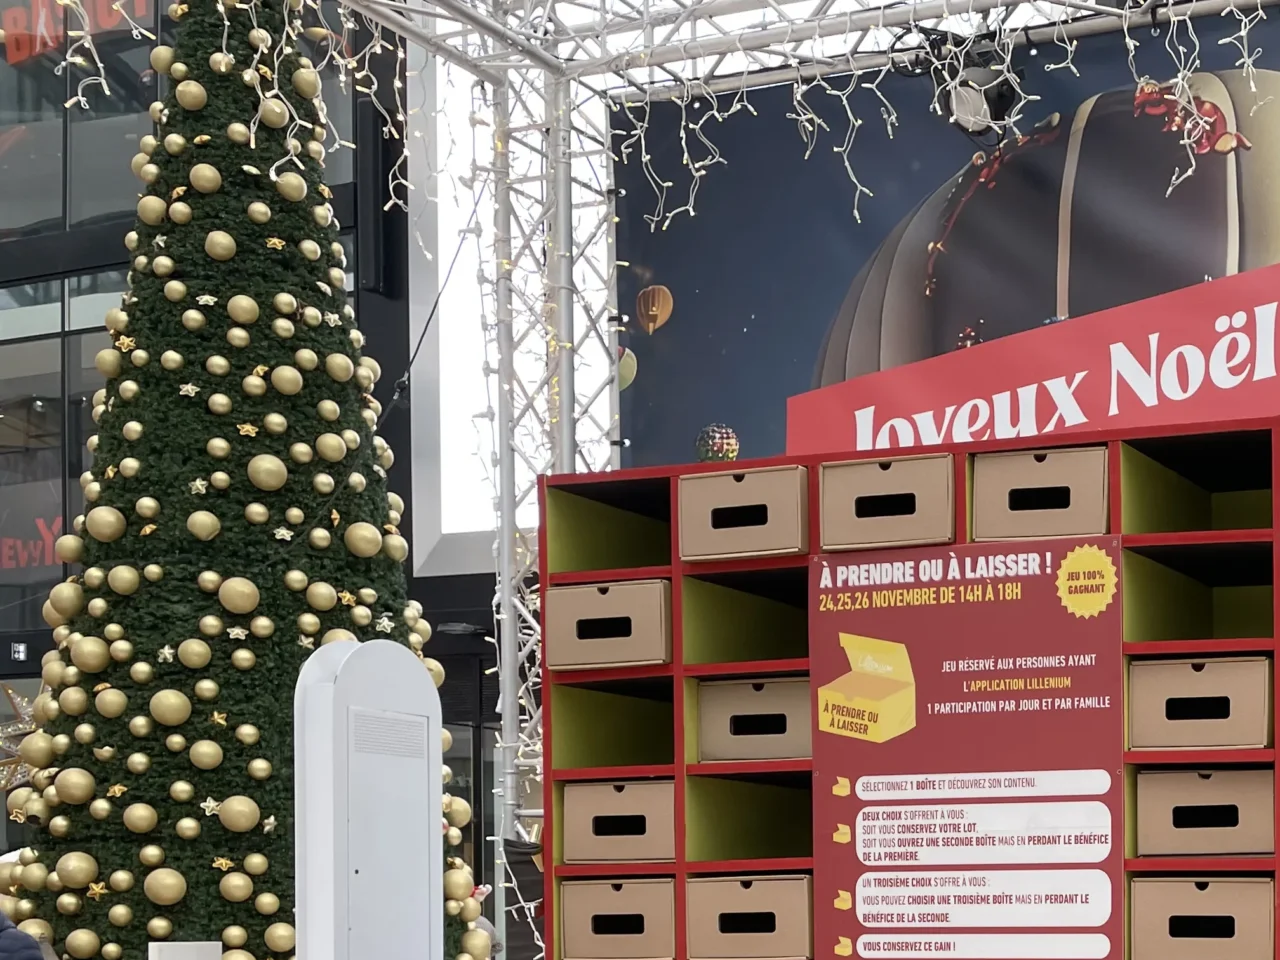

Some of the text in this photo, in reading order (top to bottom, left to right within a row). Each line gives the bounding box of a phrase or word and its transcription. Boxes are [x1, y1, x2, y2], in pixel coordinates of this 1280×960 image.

[1107, 301, 1280, 416] Noël
[820, 552, 1052, 588] À PRENDRE OU À LAISSER !
[1066, 570, 1105, 582] JEU 100%
[819, 579, 1021, 612] 24,25,26 NOVEMBRE DE 14H À 18H
[1068, 583, 1105, 595] GAGNANT
[941, 654, 1096, 673] JEU RÉSERVÉ AUX PERSONNES AYANT
[963, 677, 1071, 692] L'APPLICATION LILLENIUM
[823, 699, 879, 724] À PRENDRE OU
[927, 696, 1111, 715] 1 PARTICIPATION PAR JOUR ET PAR FAMILLE
[829, 713, 869, 735] À LAISSER
[862, 779, 908, 792] SÉLECTIONNEZ
[910, 781, 914, 790] 1
[916, 778, 936, 790] BOÎTE
[938, 780, 946, 790] ET
[948, 777, 986, 790] DÉCOUVREZ
[987, 778, 1001, 789] SON
[862, 811, 880, 821] DEUX
[881, 811, 902, 821] CHOIX
[903, 809, 938, 820] S'OFFRENT
[940, 808, 945, 819] À
[946, 809, 964, 819] VOUS
[862, 825, 876, 835] SOIT
[878, 824, 896, 834] VOUS
[897, 823, 936, 834] CONSERVEZ
[938, 823, 961, 833] VOTRE
[862, 832, 1109, 848] SOIT VOUS OUVREZ UNE SECONDE BOÎTE MAIS EN PERDANT LE BÉNÉFICE
[862, 852, 872, 862] DE
[873, 851, 882, 861] LA
[862, 878, 872, 888] UN
[873, 875, 910, 887] TROISIÈME
[911, 877, 932, 887] CHOIX
[933, 877, 960, 887] S'OFFRE
[962, 874, 967, 886] À
[968, 877, 986, 887] VOUS
[862, 891, 1089, 905] VOUS POUVEZ CHOISIR UNE TROISIÈME BOÎTE MAIS EN PERDANT LE
[862, 910, 894, 923] BÉNÉFICE
[896, 913, 905, 923] DE
[907, 913, 916, 923] LA
[863, 941, 881, 951] VOUS
[882, 941, 922, 951] CONSERVEZ
[923, 941, 932, 951] CE
[934, 941, 951, 951] GAIN
